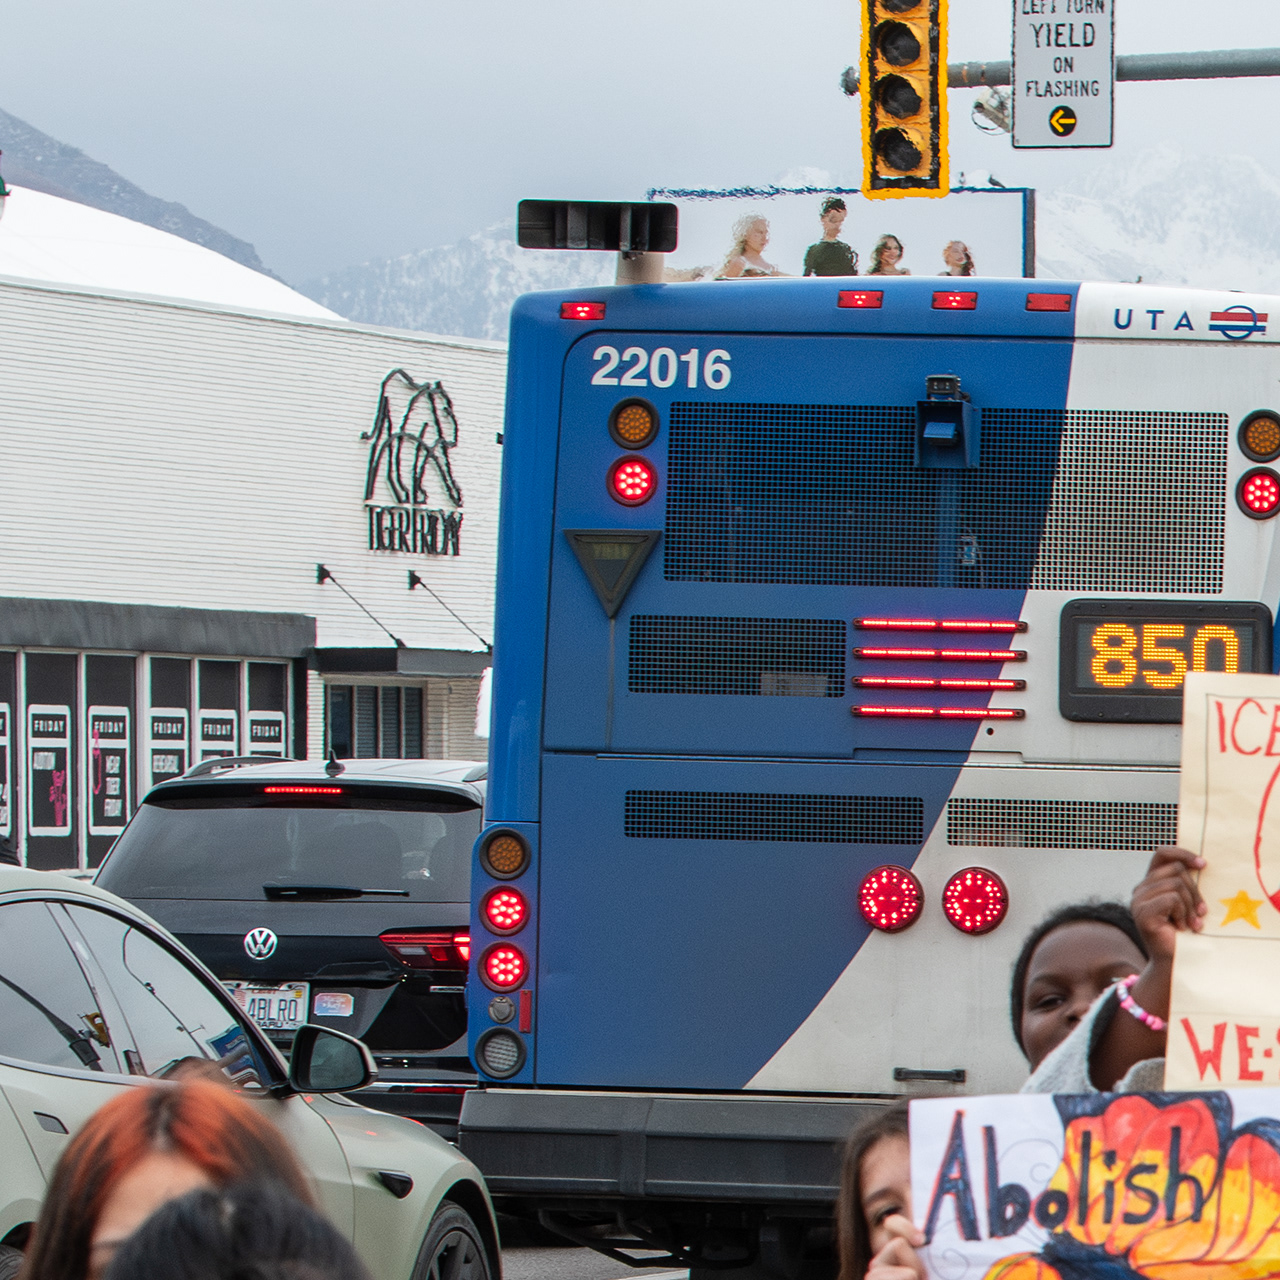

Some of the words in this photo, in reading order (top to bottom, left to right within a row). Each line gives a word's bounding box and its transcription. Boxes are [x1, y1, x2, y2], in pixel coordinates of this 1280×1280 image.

[1030, 23, 1095, 48] YIELD
[1054, 57, 1073, 73] ON
[1026, 80, 1099, 97] FLASHING
[1113, 307, 1196, 331] UTA
[591, 345, 732, 390] 22016
[1092, 623, 1239, 688] 850
[34, 720, 64, 732] FRIDAY
[94, 721, 124, 733] FRIDAY
[154, 722, 183, 734] FRIDAY
[204, 724, 232, 736] FRIDAY
[252, 726, 280, 737] FRIDAY
[1181, 1018, 1264, 1081] WE
[924, 1110, 1204, 1244] Abolish
